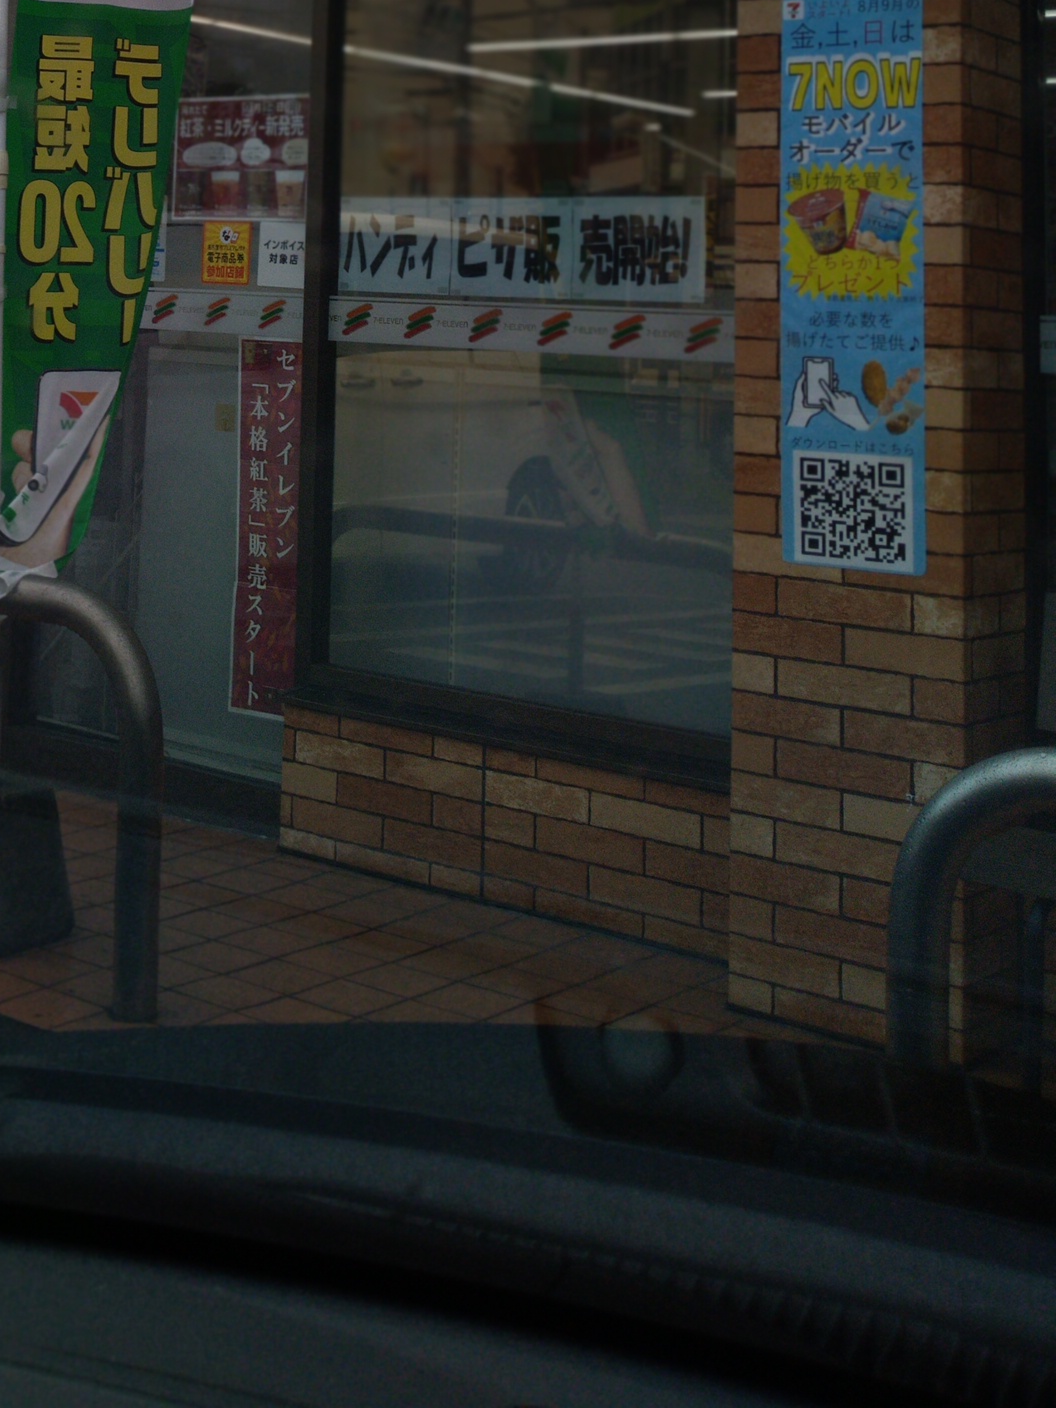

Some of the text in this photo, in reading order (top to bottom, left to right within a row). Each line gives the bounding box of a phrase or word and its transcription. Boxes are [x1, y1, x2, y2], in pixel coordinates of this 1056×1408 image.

[788, 57, 922, 111] 7NOW
[801, 113, 901, 135] モバイル
[789, 139, 916, 163] オーダーで
[263, 239, 305, 251] インボイス
[269, 253, 299, 265] 対象店
[792, 271, 909, 295] プレゼント
[809, 311, 893, 329] 必要な数を
[276, 349, 296, 560] セブンイレブン
[791, 436, 915, 456] ダウンロードはこちら
[244, 382, 269, 707] 「本格紅茶」販売スタート
